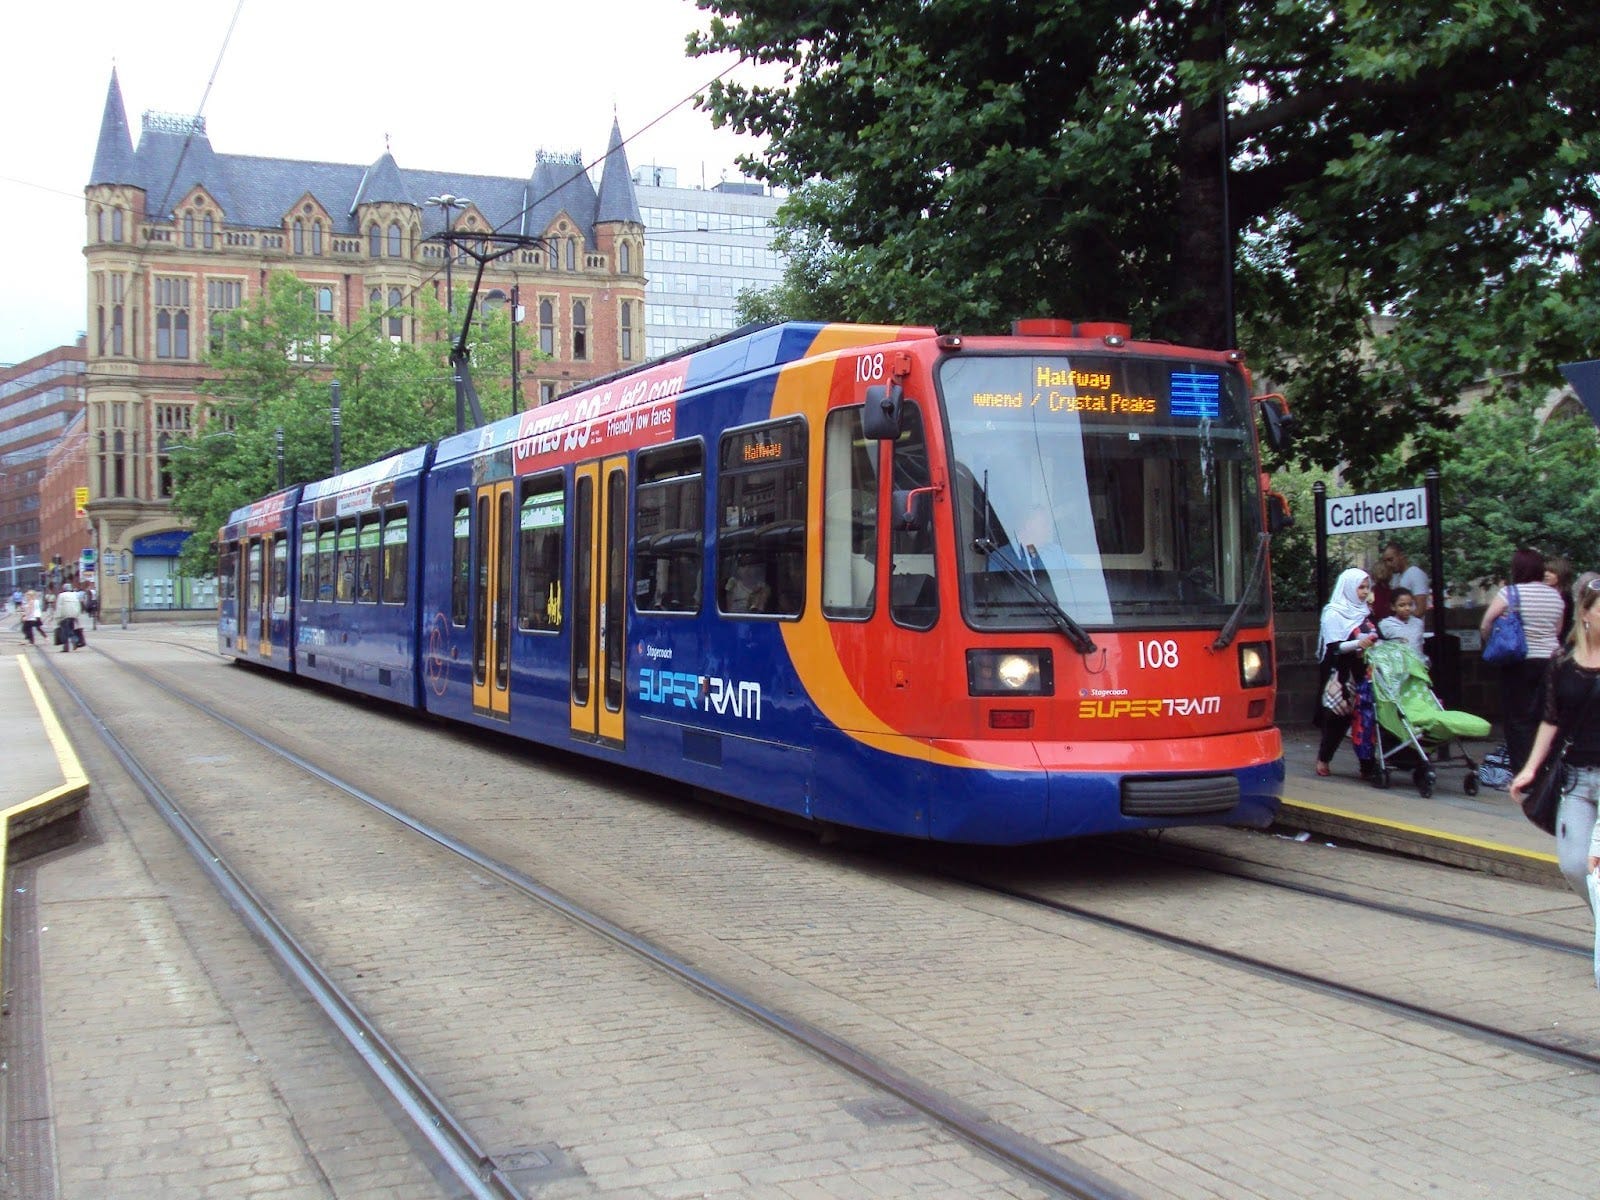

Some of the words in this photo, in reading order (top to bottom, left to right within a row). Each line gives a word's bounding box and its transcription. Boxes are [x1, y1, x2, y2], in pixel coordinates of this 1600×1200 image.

[855, 351, 885, 381] 108
[1036, 366, 1111, 390] Halfway
[1030, 392, 1041, 407] /
[1049, 391, 1108, 413] Crystal
[1110, 393, 1157, 414] Peaks
[607, 411, 634, 438] Friendly
[635, 408, 649, 430] low
[650, 405, 672, 426] fares
[744, 442, 782, 462] Halfway
[1331, 495, 1422, 527] Cathedral
[646, 644, 673, 661] Stagecoach
[1138, 639, 1179, 669] 108
[1091, 687, 1129, 697] Stagecoach
[1078, 695, 1221, 719] SUPERTRAM
